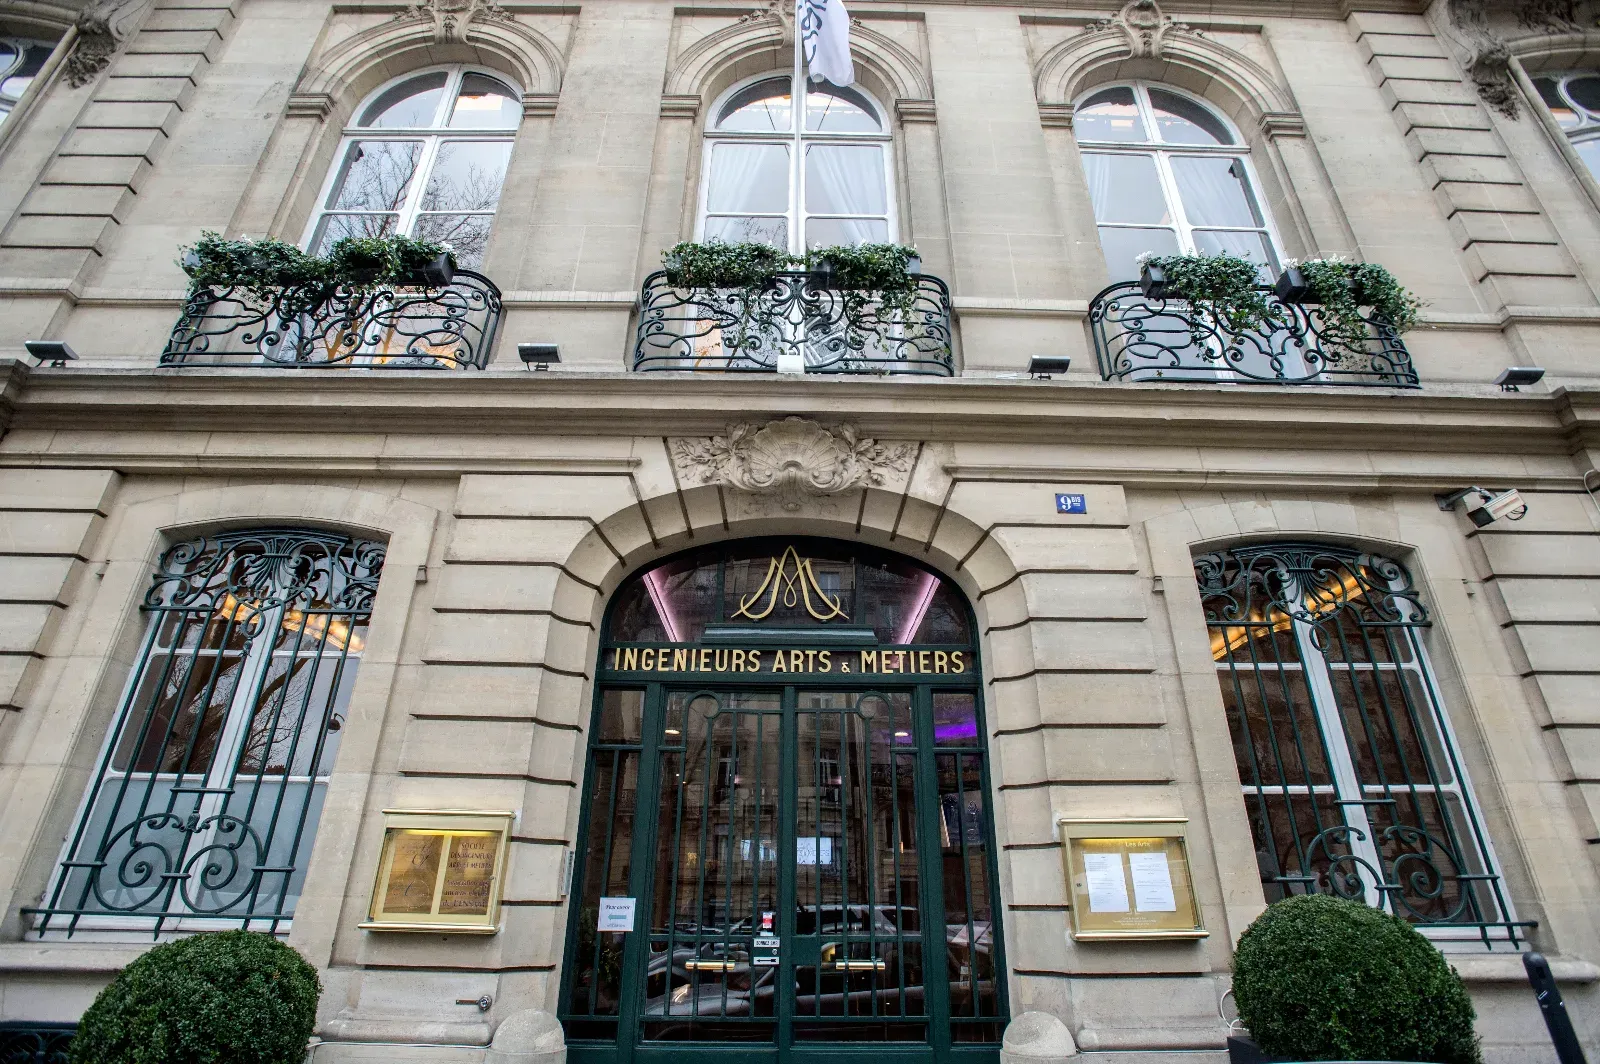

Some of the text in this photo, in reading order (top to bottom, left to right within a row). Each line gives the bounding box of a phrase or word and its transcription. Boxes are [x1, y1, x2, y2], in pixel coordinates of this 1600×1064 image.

[1060, 495, 1071, 511] 9
[614, 647, 965, 674] INGENIEURS ARTS & METIERS
